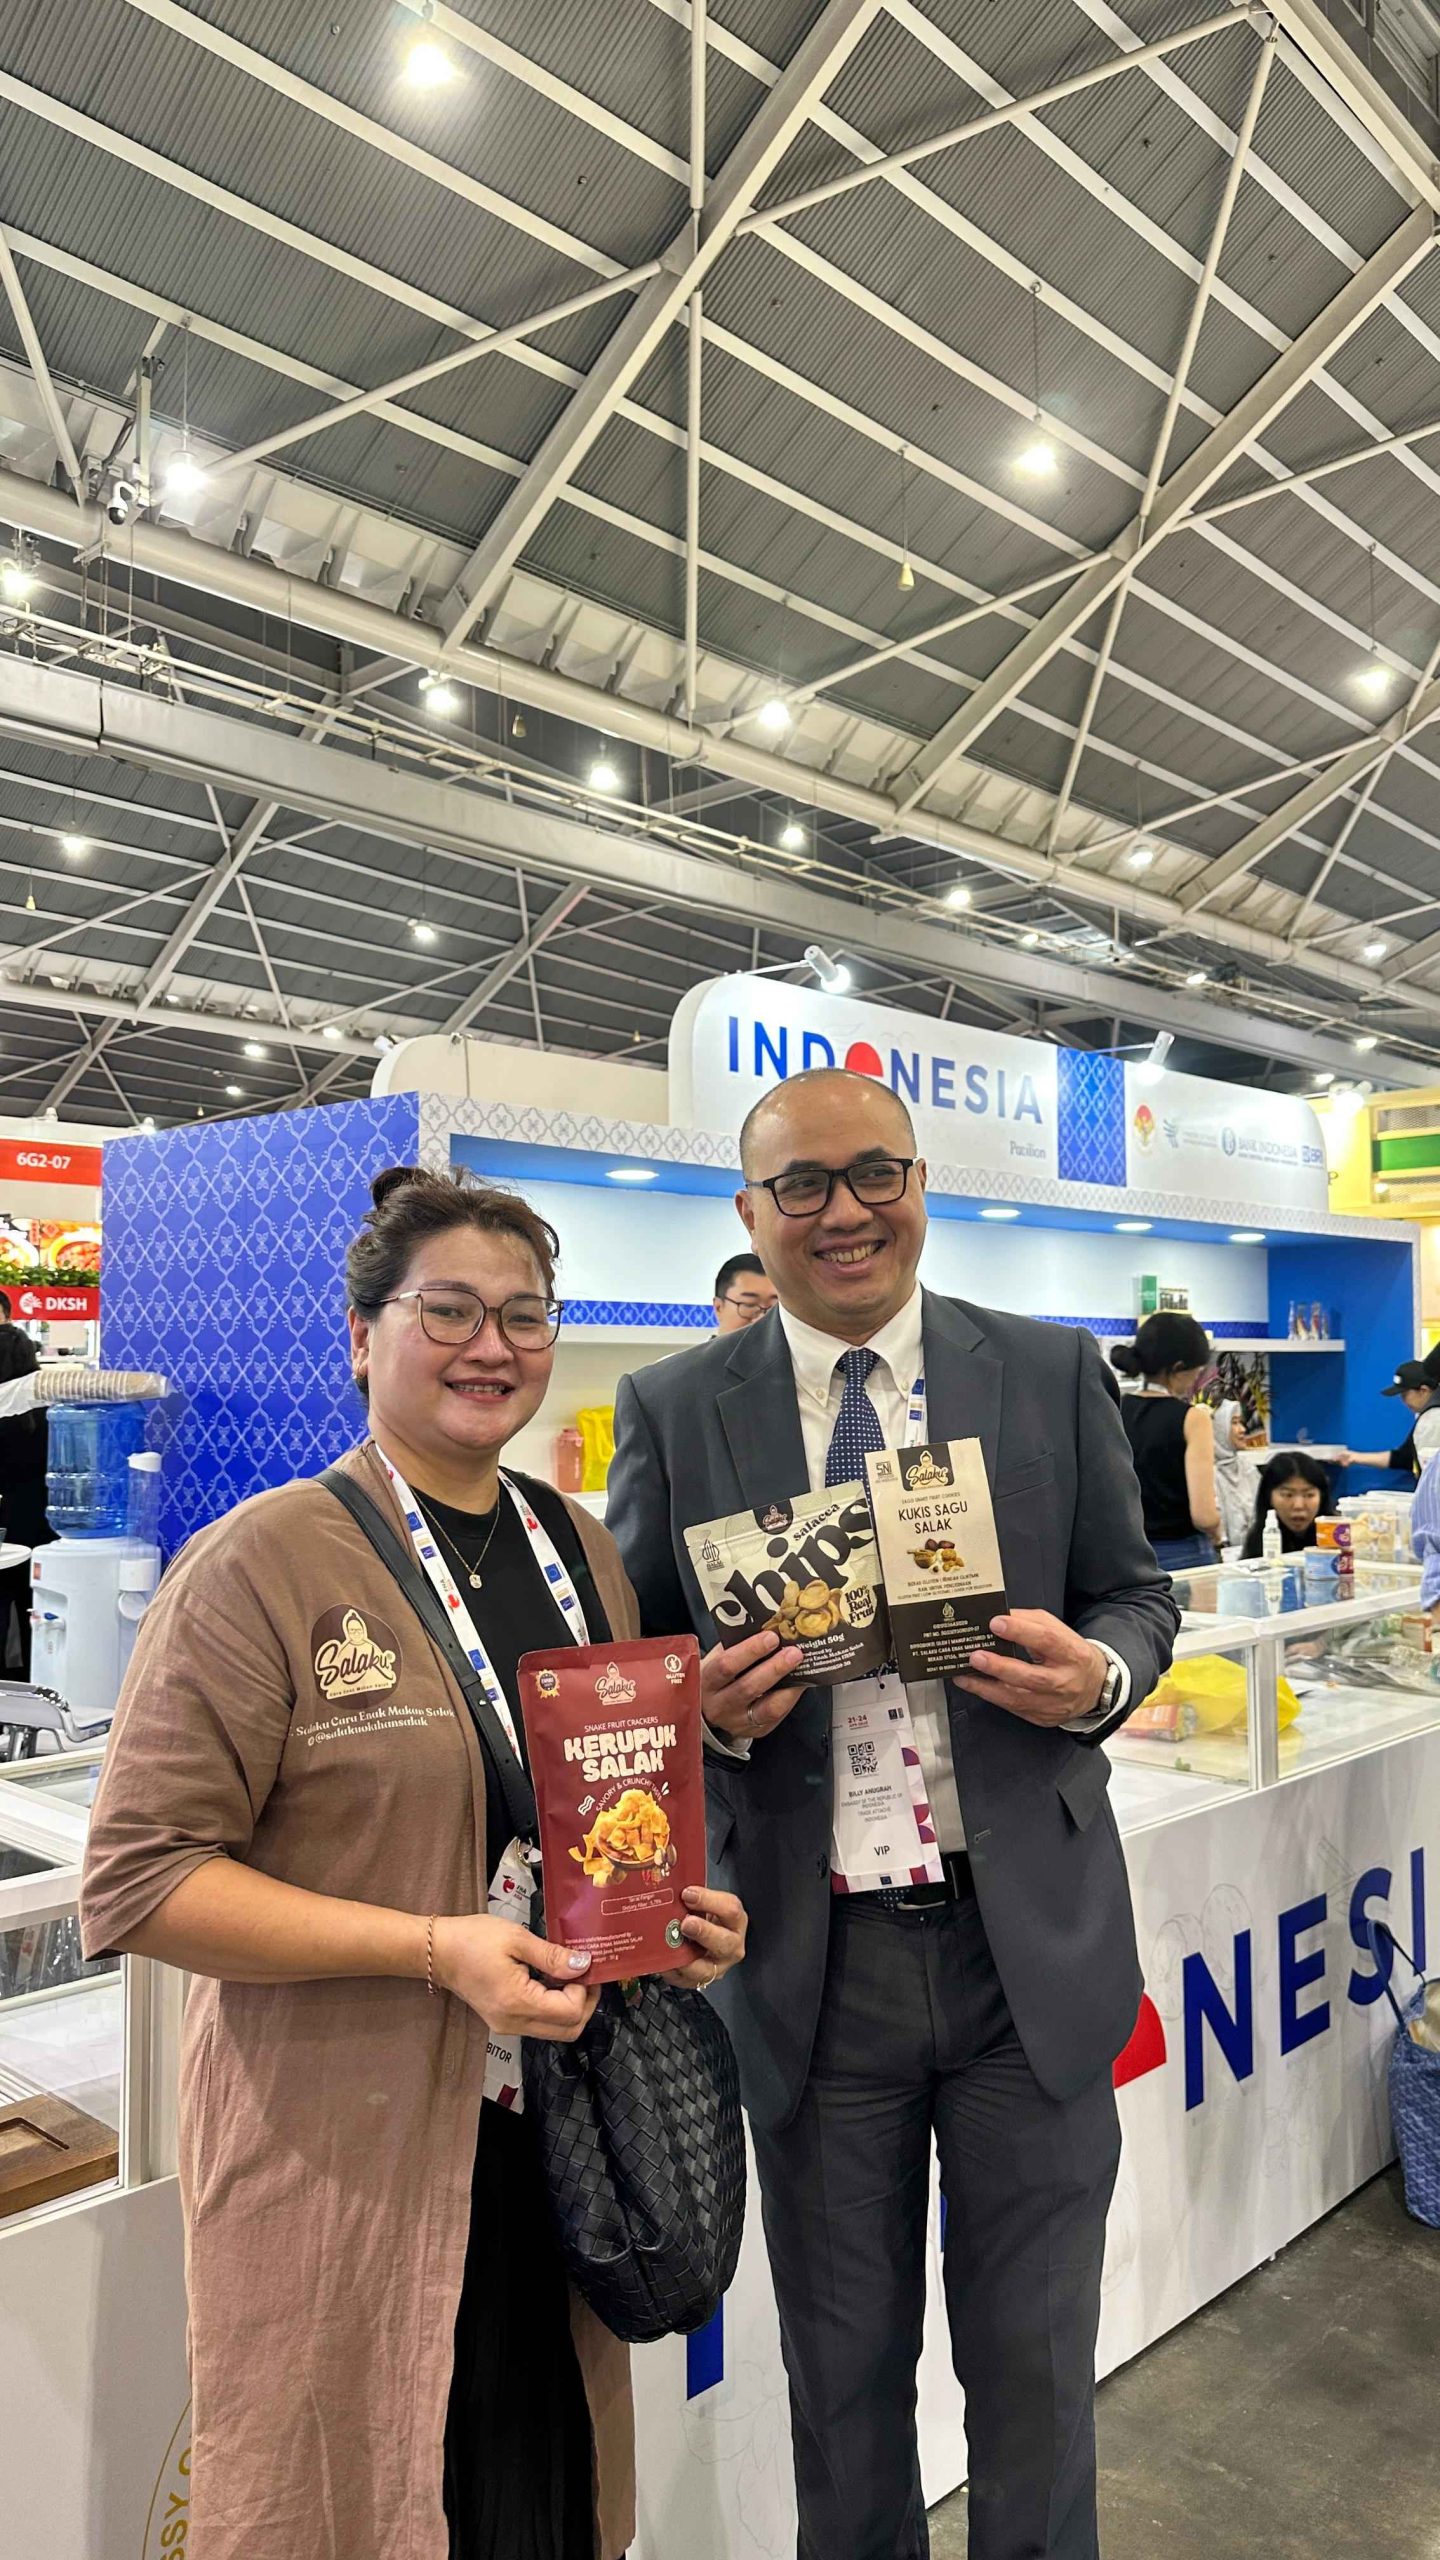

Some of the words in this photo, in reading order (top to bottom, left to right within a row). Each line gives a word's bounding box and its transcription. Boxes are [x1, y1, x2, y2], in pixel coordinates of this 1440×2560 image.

[16, 1152, 72, 1170] 6G2-07
[45, 1296, 88, 1312] DKSH
[793, 1502, 841, 1542] salacca
[898, 1505, 931, 1522] KUKIS
[935, 1501, 968, 1515] SAGU
[914, 1518, 953, 1535] SALAK
[714, 1498, 875, 1628] chips
[844, 1584, 869, 1603] 100%
[849, 1594, 872, 1613] Real
[848, 1605, 874, 1624] Fruit
[317, 1642, 394, 1686] Salaku
[596, 1676, 635, 1699] Salaku
[330, 1714, 358, 1728] Cara
[359, 1709, 387, 1721] Enak
[387, 1704, 425, 1717] Makan
[584, 1722, 607, 1733] SNAKE
[607, 1719, 627, 1730] FRUIT
[626, 1716, 659, 1727] CRACKERS
[563, 1724, 677, 1763] KERUPUK
[582, 1748, 665, 1783] SALAK
[595, 1786, 617, 1812] SAVORY
[848, 1787, 864, 1798] BILLY
[873, 1845, 891, 1857] VIP
[486, 2042, 513, 2064] BITOR
